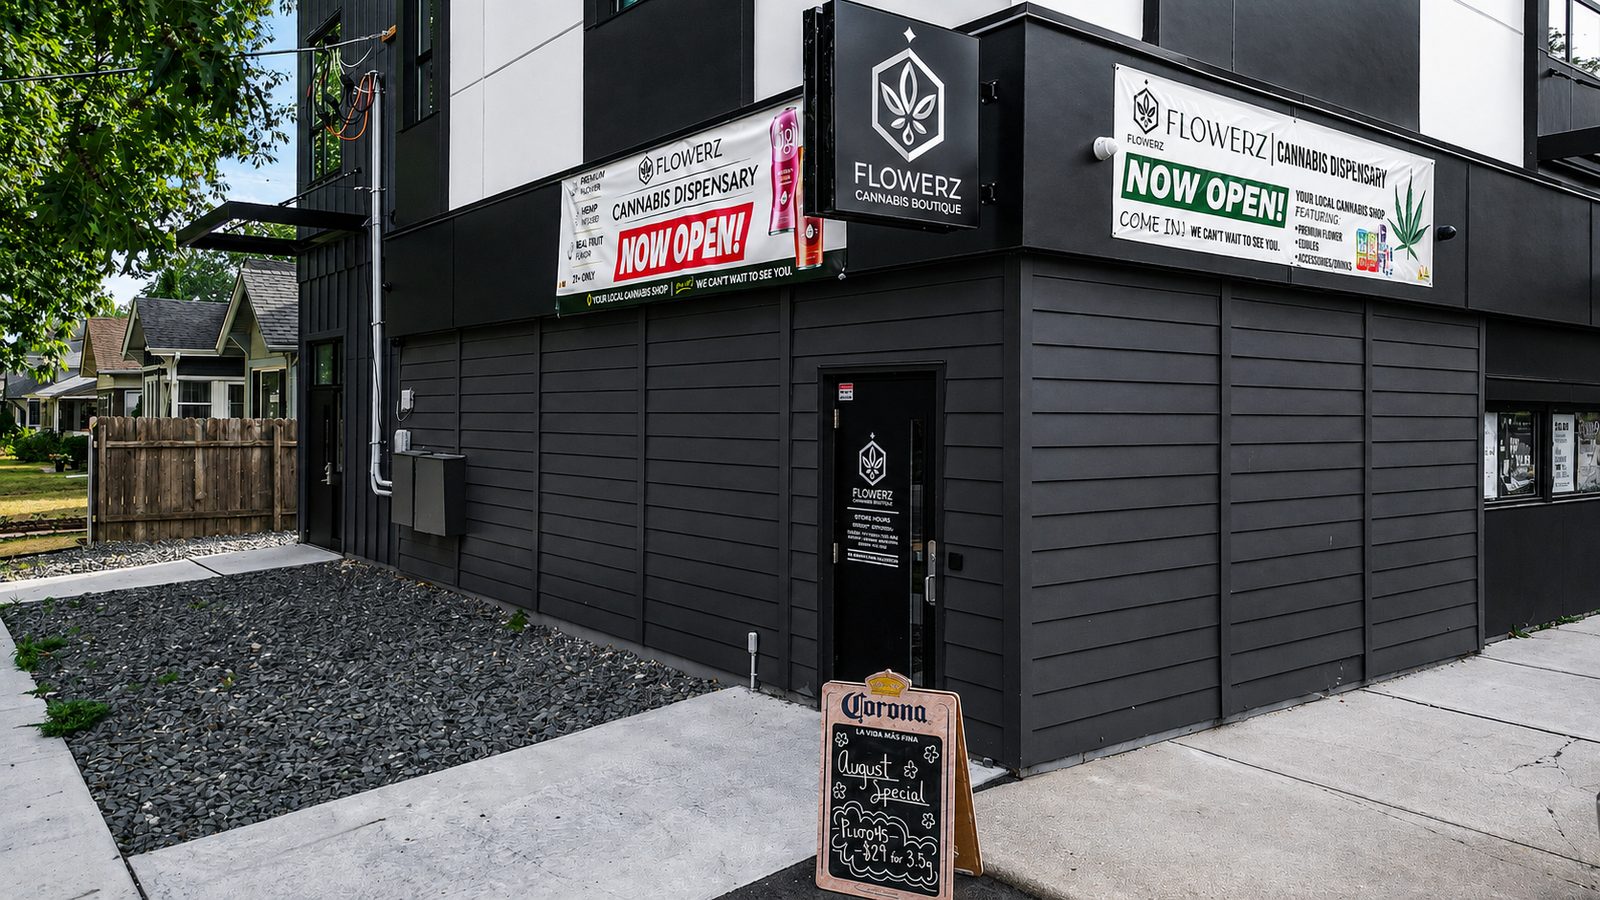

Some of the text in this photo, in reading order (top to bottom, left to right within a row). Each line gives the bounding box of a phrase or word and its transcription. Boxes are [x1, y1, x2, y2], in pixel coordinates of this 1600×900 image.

[656, 138, 722, 175] FLOWERZ
[1127, 133, 1165, 151] FLOWERZ
[1166, 108, 1388, 189] FLOWERZ CANNABIS DISPENSARY
[612, 189, 670, 221] CANNABIS
[674, 165, 759, 205] DISPENSARY
[854, 161, 962, 200] FLOWERZ
[1126, 158, 1285, 222] NOW OPEN!
[855, 189, 962, 215] CANNABIS BOUTIQUE
[1295, 190, 1386, 220] YOUR LOCAL CANNABIS SHOP
[1295, 206, 1341, 225] FEATURING:
[618, 211, 746, 275] NOW OPEN!
[1119, 210, 1160, 233] COME
[1190, 225, 1201, 238] WE
[1203, 227, 1223, 242] CAN'T
[1225, 231, 1242, 245] WAIT
[1242, 234, 1251, 247] TO
[1252, 236, 1264, 249] SEE
[1265, 238, 1280, 251] YOU.
[581, 270, 595, 282] ONLY
[592, 294, 607, 304] YOUR
[607, 292, 623, 303] LOCAL
[624, 287, 651, 300] CANNABIS
[651, 284, 669, 296] SHOP
[696, 278, 707, 288] WE
[708, 275, 728, 287] CAN'T
[729, 272, 748, 284] WAIT
[748, 271, 759, 281] TO
[759, 268, 773, 280] SEE
[773, 266, 793, 277] YOU.
[852, 487, 893, 501] FLOWERZ
[841, 691, 927, 724] Corona
[855, 728, 919, 743] LA VIDA MÁS FINA
[837, 749, 892, 790] August
[869, 778, 927, 808] Special
[890, 850, 903, 864] for
[906, 849, 933, 881] 3.5g
